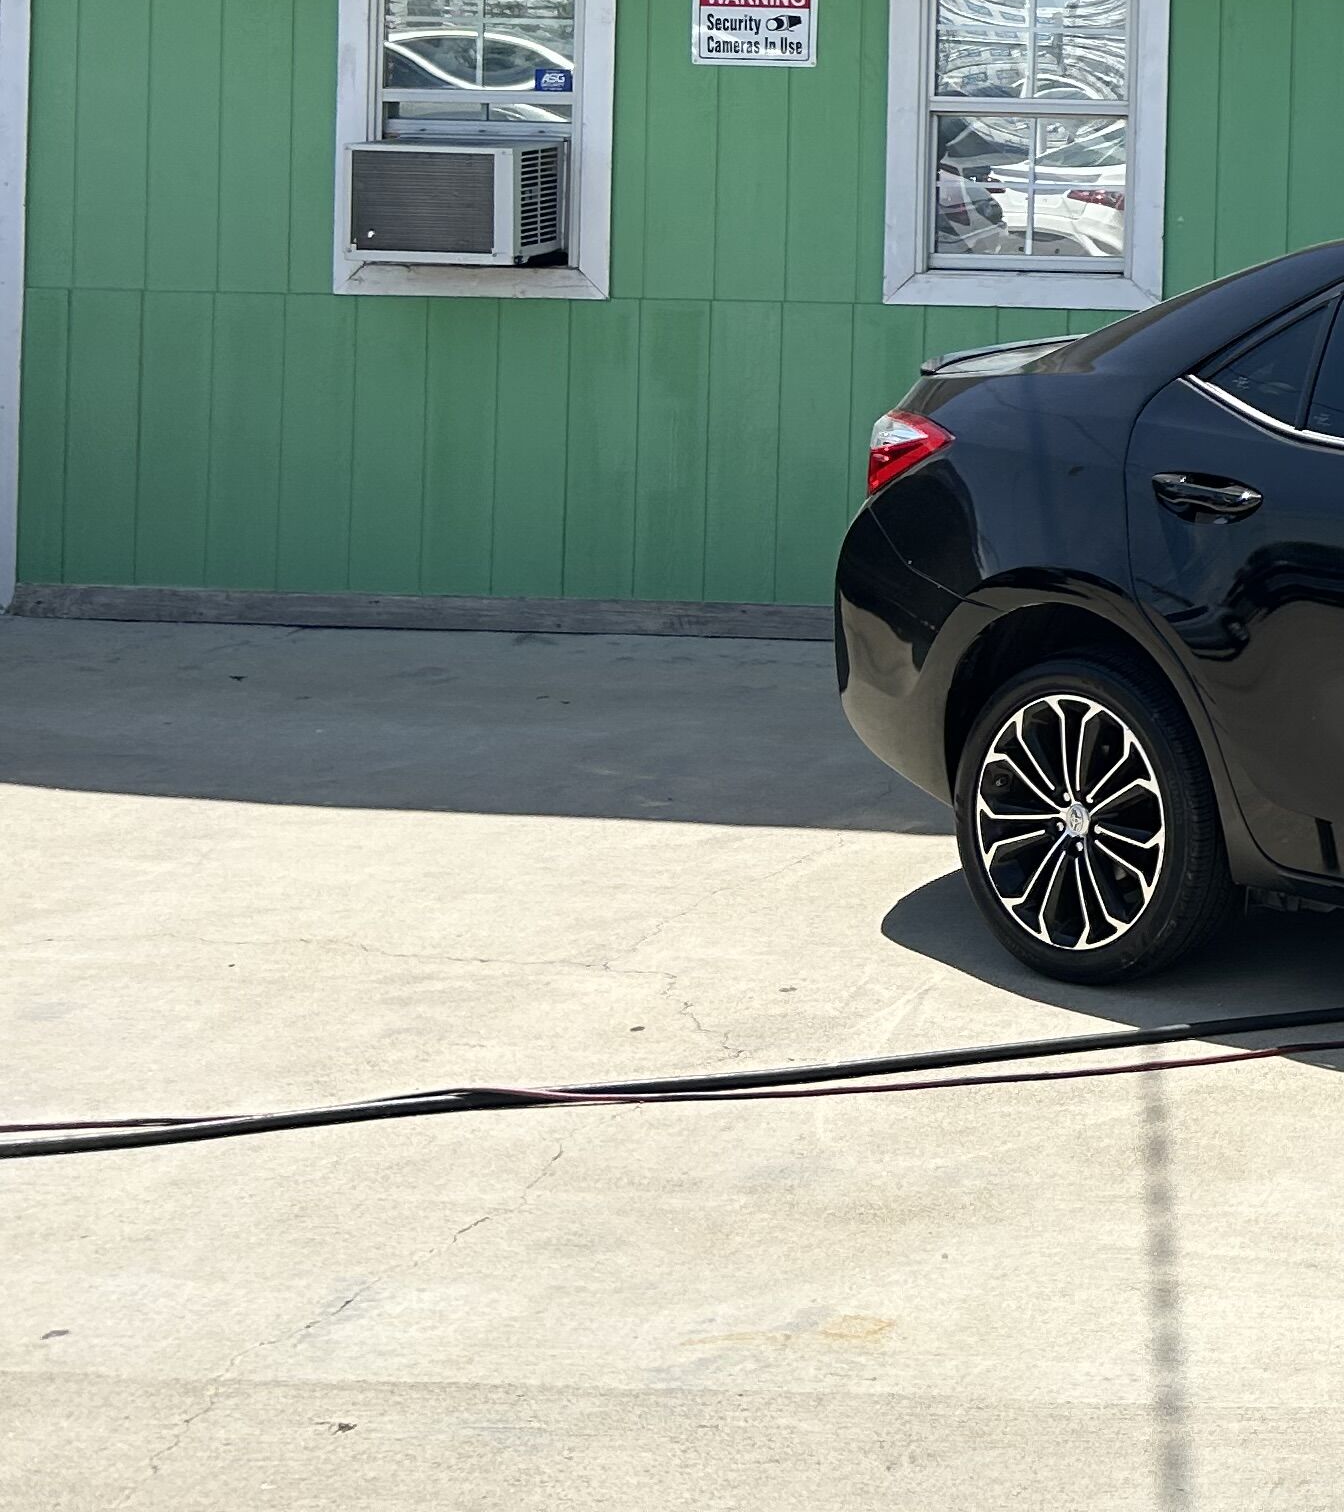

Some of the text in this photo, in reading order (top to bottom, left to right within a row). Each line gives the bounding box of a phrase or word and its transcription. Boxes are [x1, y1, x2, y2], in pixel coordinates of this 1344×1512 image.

[706, 13, 762, 36] Security
[706, 35, 761, 54] Cameras
[780, 36, 803, 55] Use
